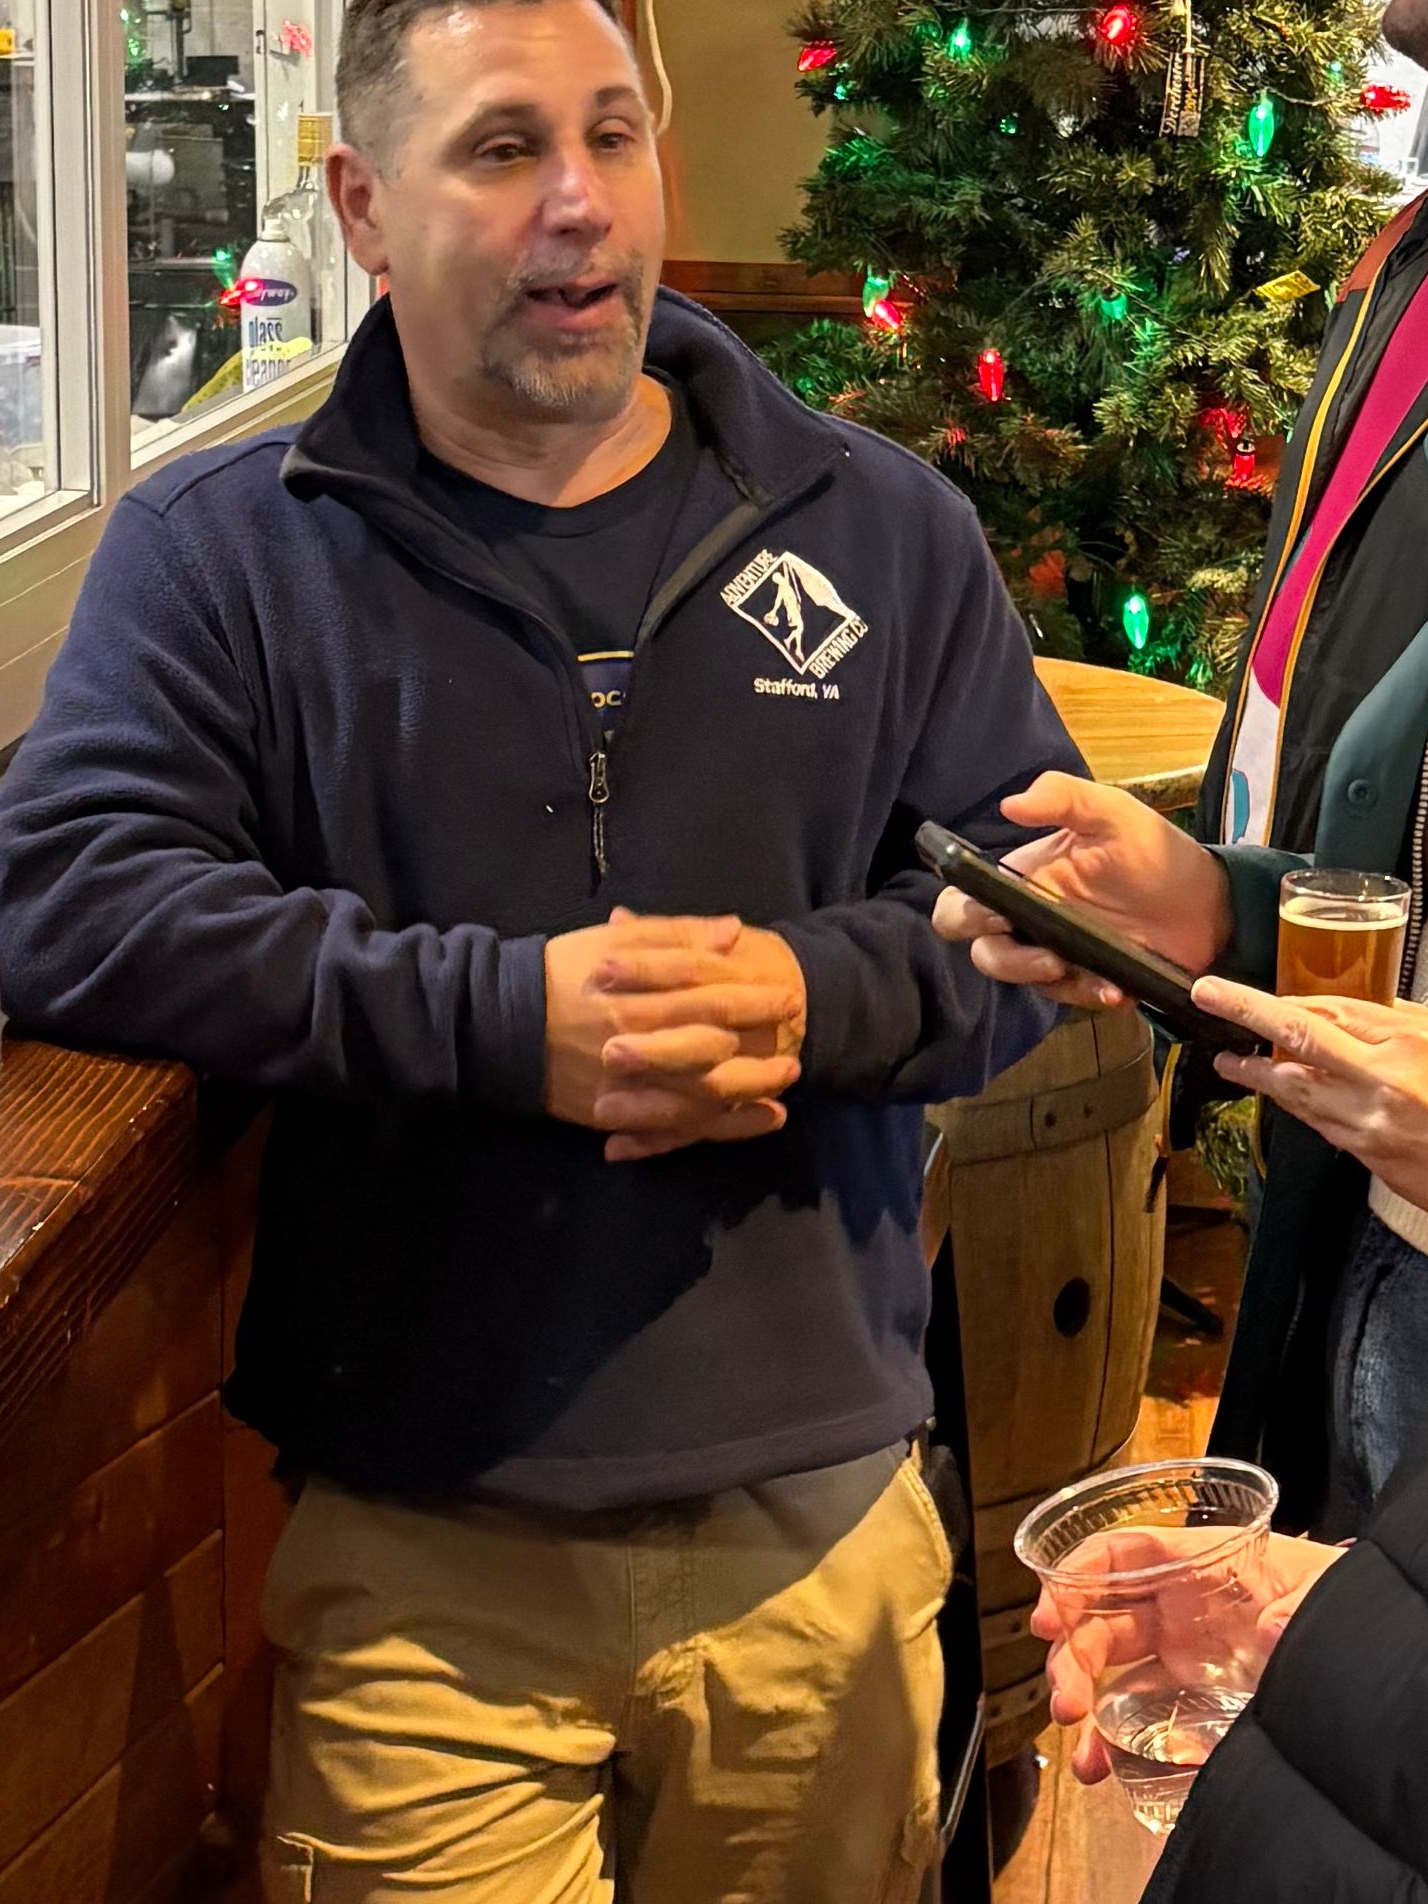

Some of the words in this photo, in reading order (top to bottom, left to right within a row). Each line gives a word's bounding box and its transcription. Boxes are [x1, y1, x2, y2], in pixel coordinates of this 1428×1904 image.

[720, 549, 779, 607] ADVENTURE
[808, 627, 858, 679] BREWING
[753, 678, 818, 700] Stafford,
[822, 683, 840, 700] VA
